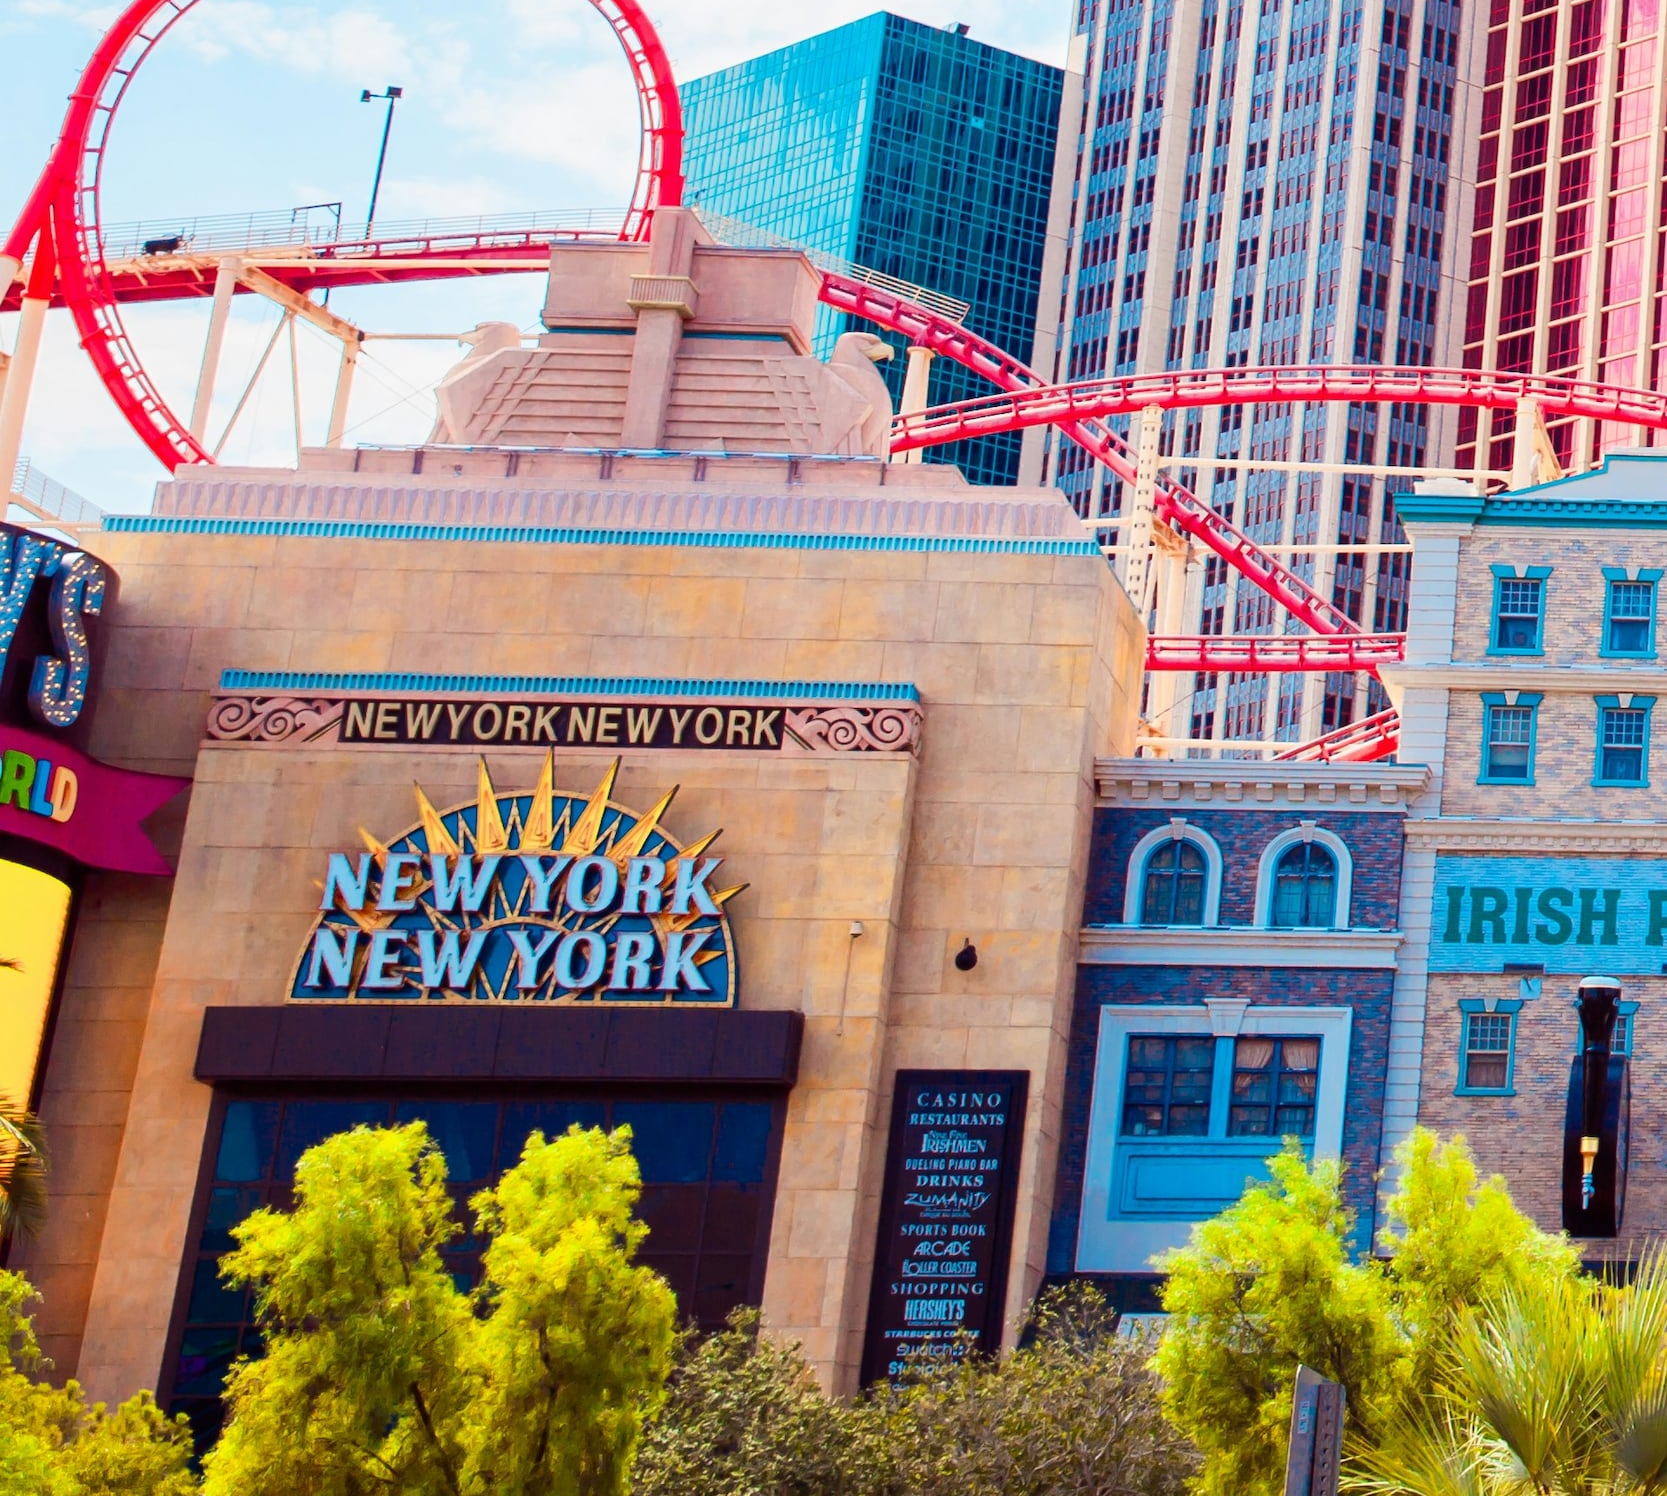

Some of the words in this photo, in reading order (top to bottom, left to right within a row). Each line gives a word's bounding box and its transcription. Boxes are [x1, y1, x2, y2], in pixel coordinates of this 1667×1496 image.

[318, 852, 502, 912] NEW
[518, 854, 726, 916] YORK
[1442, 885, 1621, 945] IRISH
[304, 928, 491, 990] NEW
[507, 930, 714, 993] YORK
[917, 1092, 1002, 1108] CASINO
[909, 1113, 1005, 1126] RESTAURANTS
[920, 1132, 988, 1154] IRISHMEN
[904, 1158, 946, 1171] DUELING
[948, 1158, 977, 1171] PIANO
[979, 1158, 999, 1171] BAR
[916, 1174, 984, 1188] DRINKS
[900, 1223, 948, 1237] SPORTS
[951, 1223, 987, 1237] BOOK
[913, 1240, 972, 1256] ARCADE
[902, 1258, 939, 1276] ROLLER
[940, 1260, 977, 1274] COASTER
[890, 1282, 984, 1296] SHOPPING
[904, 1299, 966, 1321] HERSHEY'S
[884, 1329, 942, 1339] STARBUCKS
